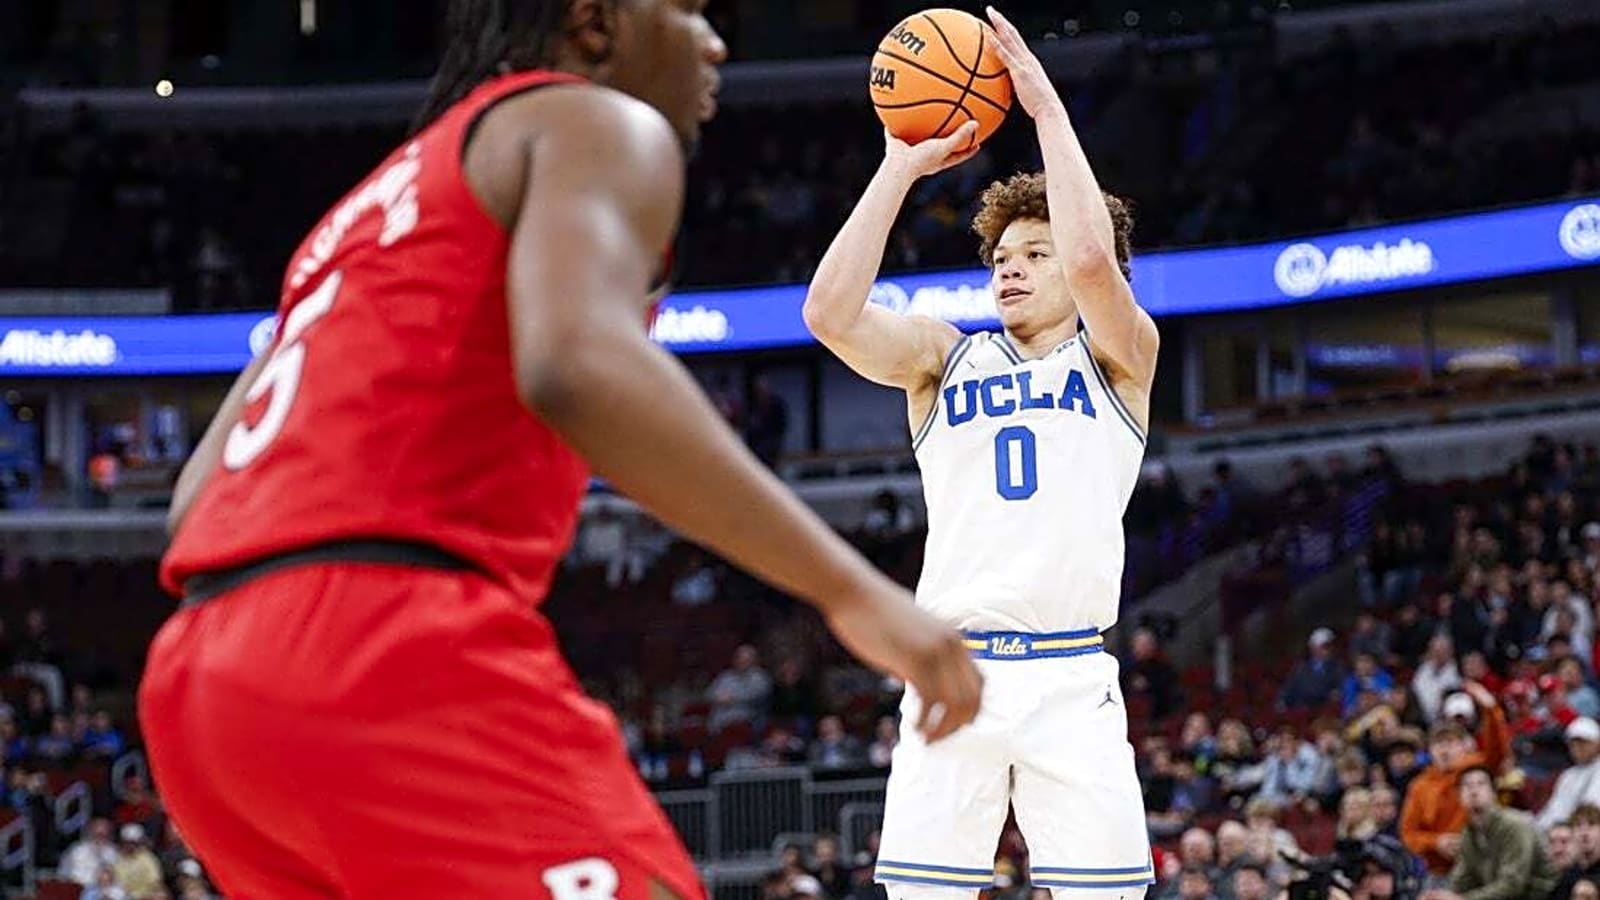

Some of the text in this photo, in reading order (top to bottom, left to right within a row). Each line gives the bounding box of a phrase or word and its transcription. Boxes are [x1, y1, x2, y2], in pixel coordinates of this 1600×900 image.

[1323, 237, 1433, 285] Allstate
[0, 329, 118, 367] Allstate
[943, 368, 1097, 427] UCLA
[994, 425, 1038, 501] 0
[991, 636, 1028, 655] Ucla
